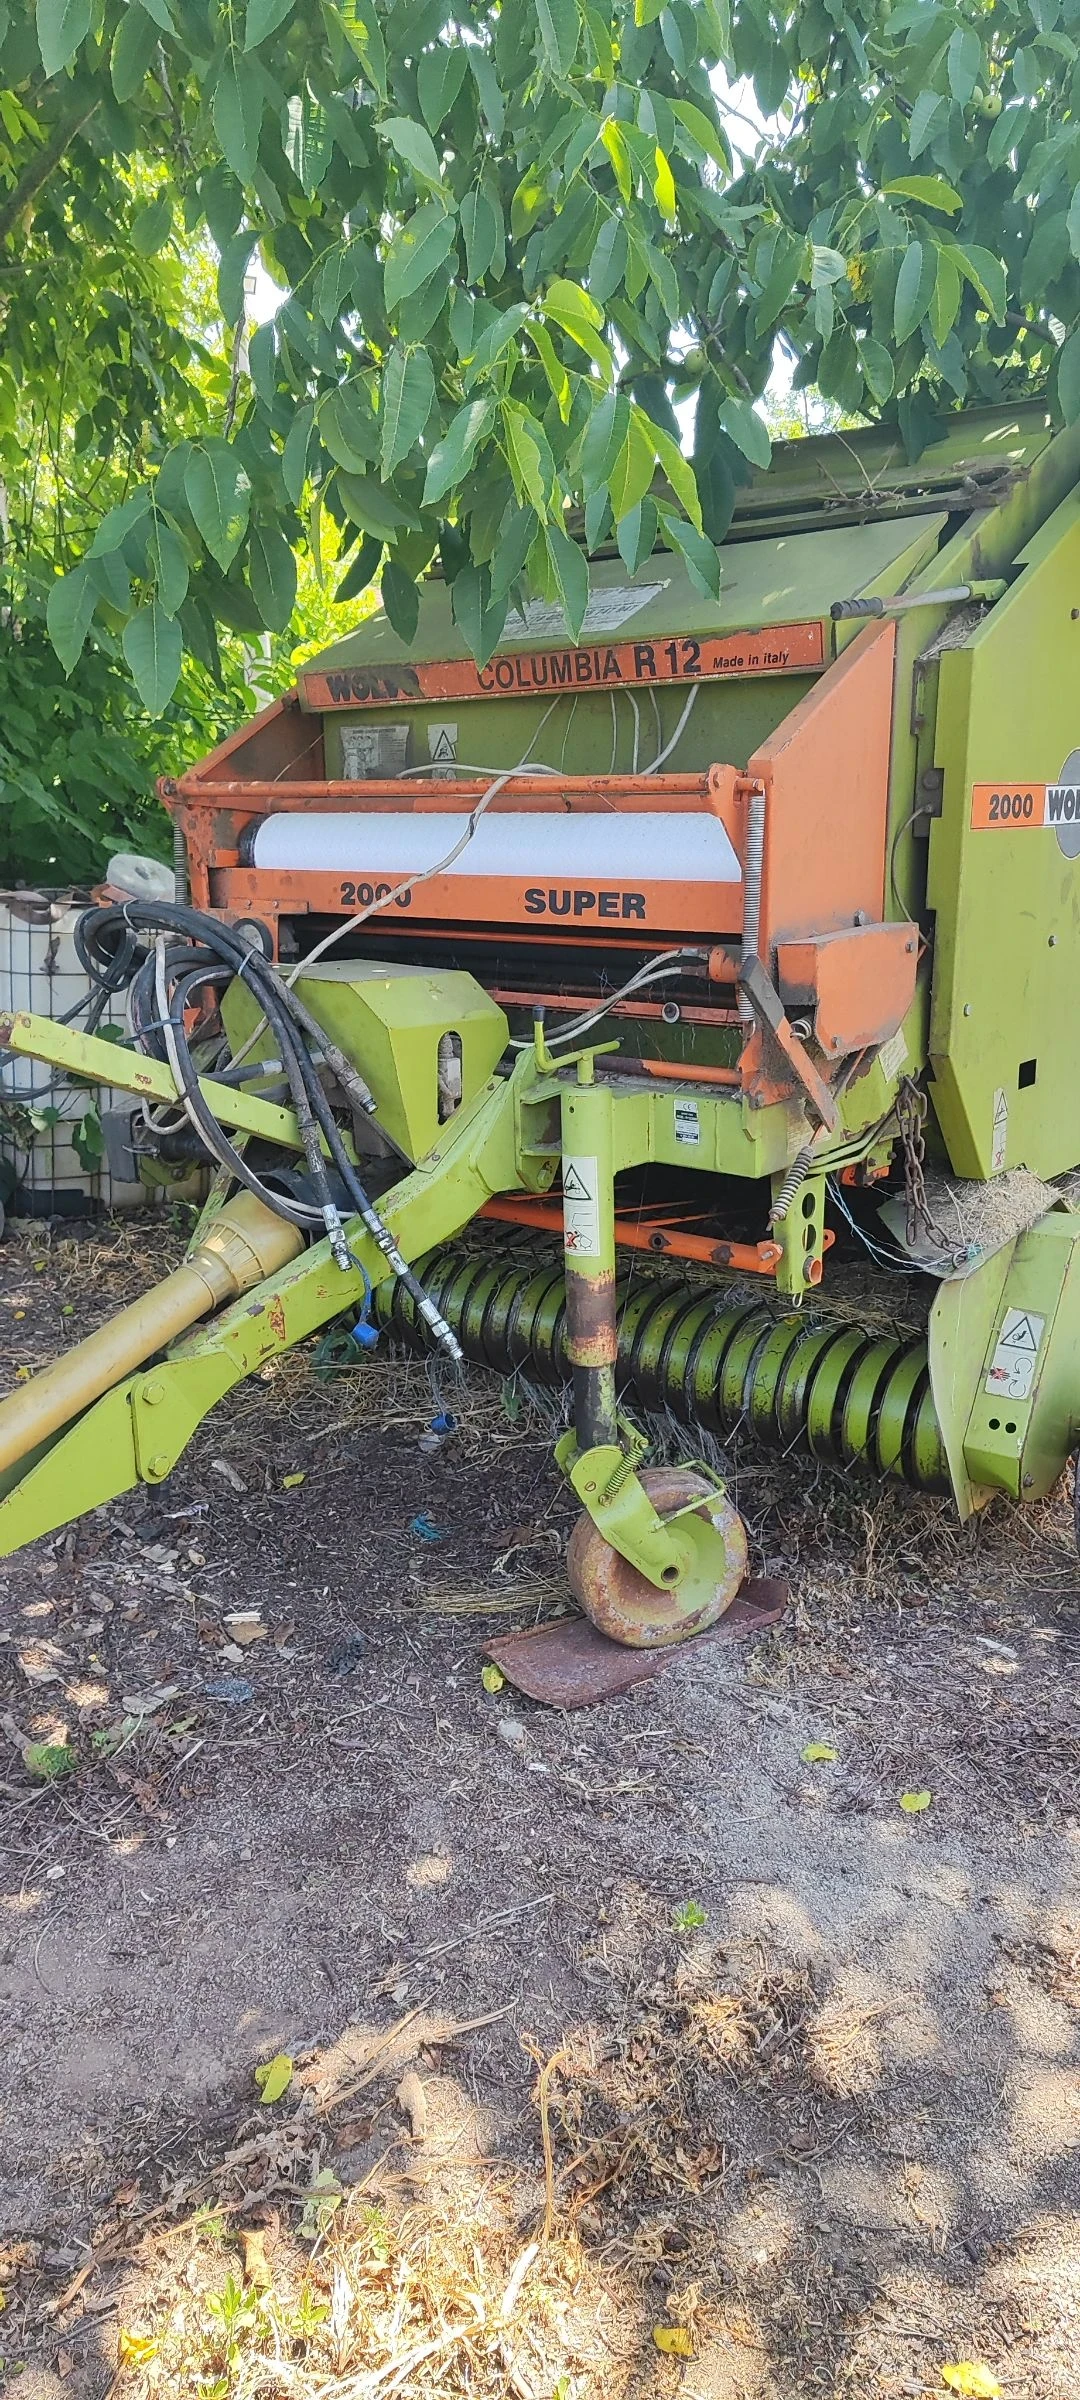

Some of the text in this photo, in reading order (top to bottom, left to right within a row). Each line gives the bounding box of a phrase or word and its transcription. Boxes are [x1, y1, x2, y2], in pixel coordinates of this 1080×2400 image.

[477, 650, 622, 690] COLUMBIA
[634, 645, 657, 678] R
[665, 639, 701, 674] 12
[713, 656, 744, 669] Made
[748, 654, 759, 665] in
[763, 651, 790, 665] italy
[989, 793, 1034, 820] 2000
[340, 882, 646, 919] 2000 SUPER
